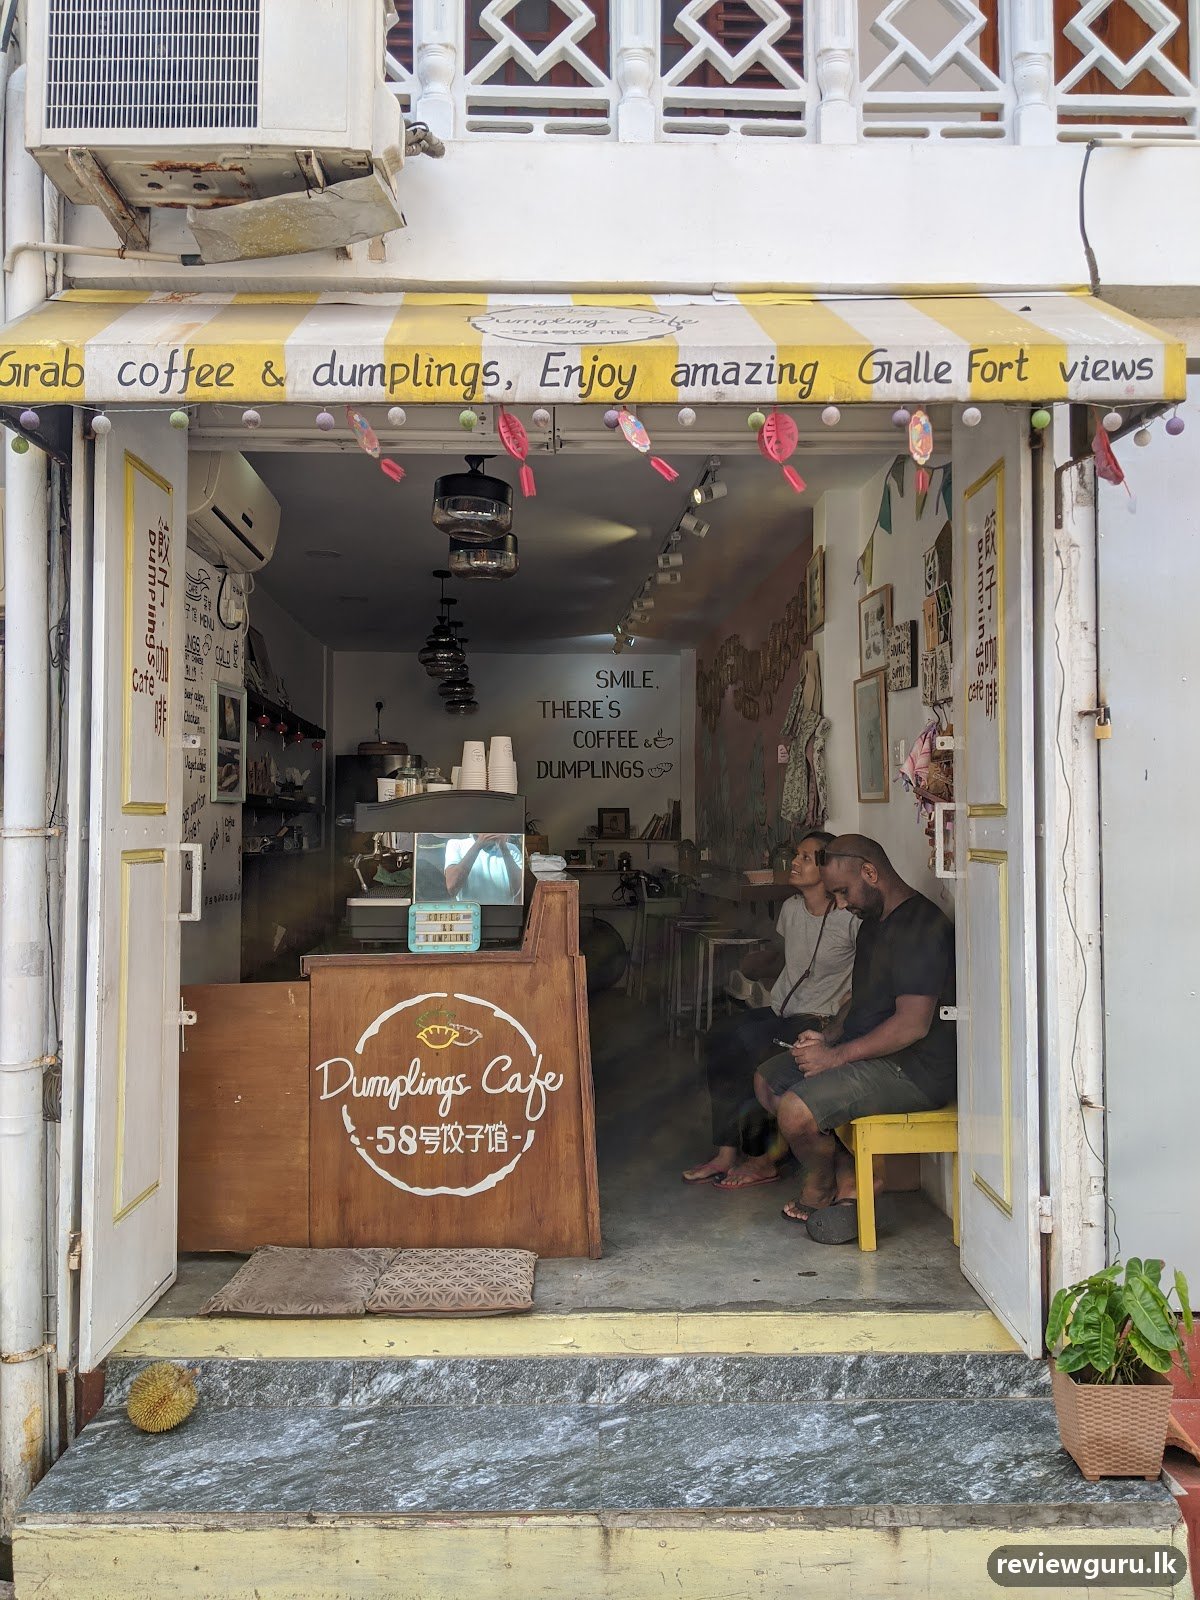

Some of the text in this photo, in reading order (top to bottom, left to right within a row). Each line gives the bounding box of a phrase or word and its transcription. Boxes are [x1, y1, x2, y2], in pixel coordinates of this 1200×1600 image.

[463, 315, 700, 328] Dumplings Cafe
[0, 347, 1154, 401] Grab coffee & dumplings, Enjoy amazing Galle Fort views
[145, 528, 157, 668] Dumplings
[199, 612, 215, 631] MENU
[132, 667, 155, 697] Cafe
[536, 694, 622, 719] THERE'S
[572, 730, 652, 749] COFFEE &
[184, 754, 207, 779] Vegetables
[536, 760, 645, 779] DUMPLINGS
[315, 1053, 565, 1122] Dumplings Cafe
